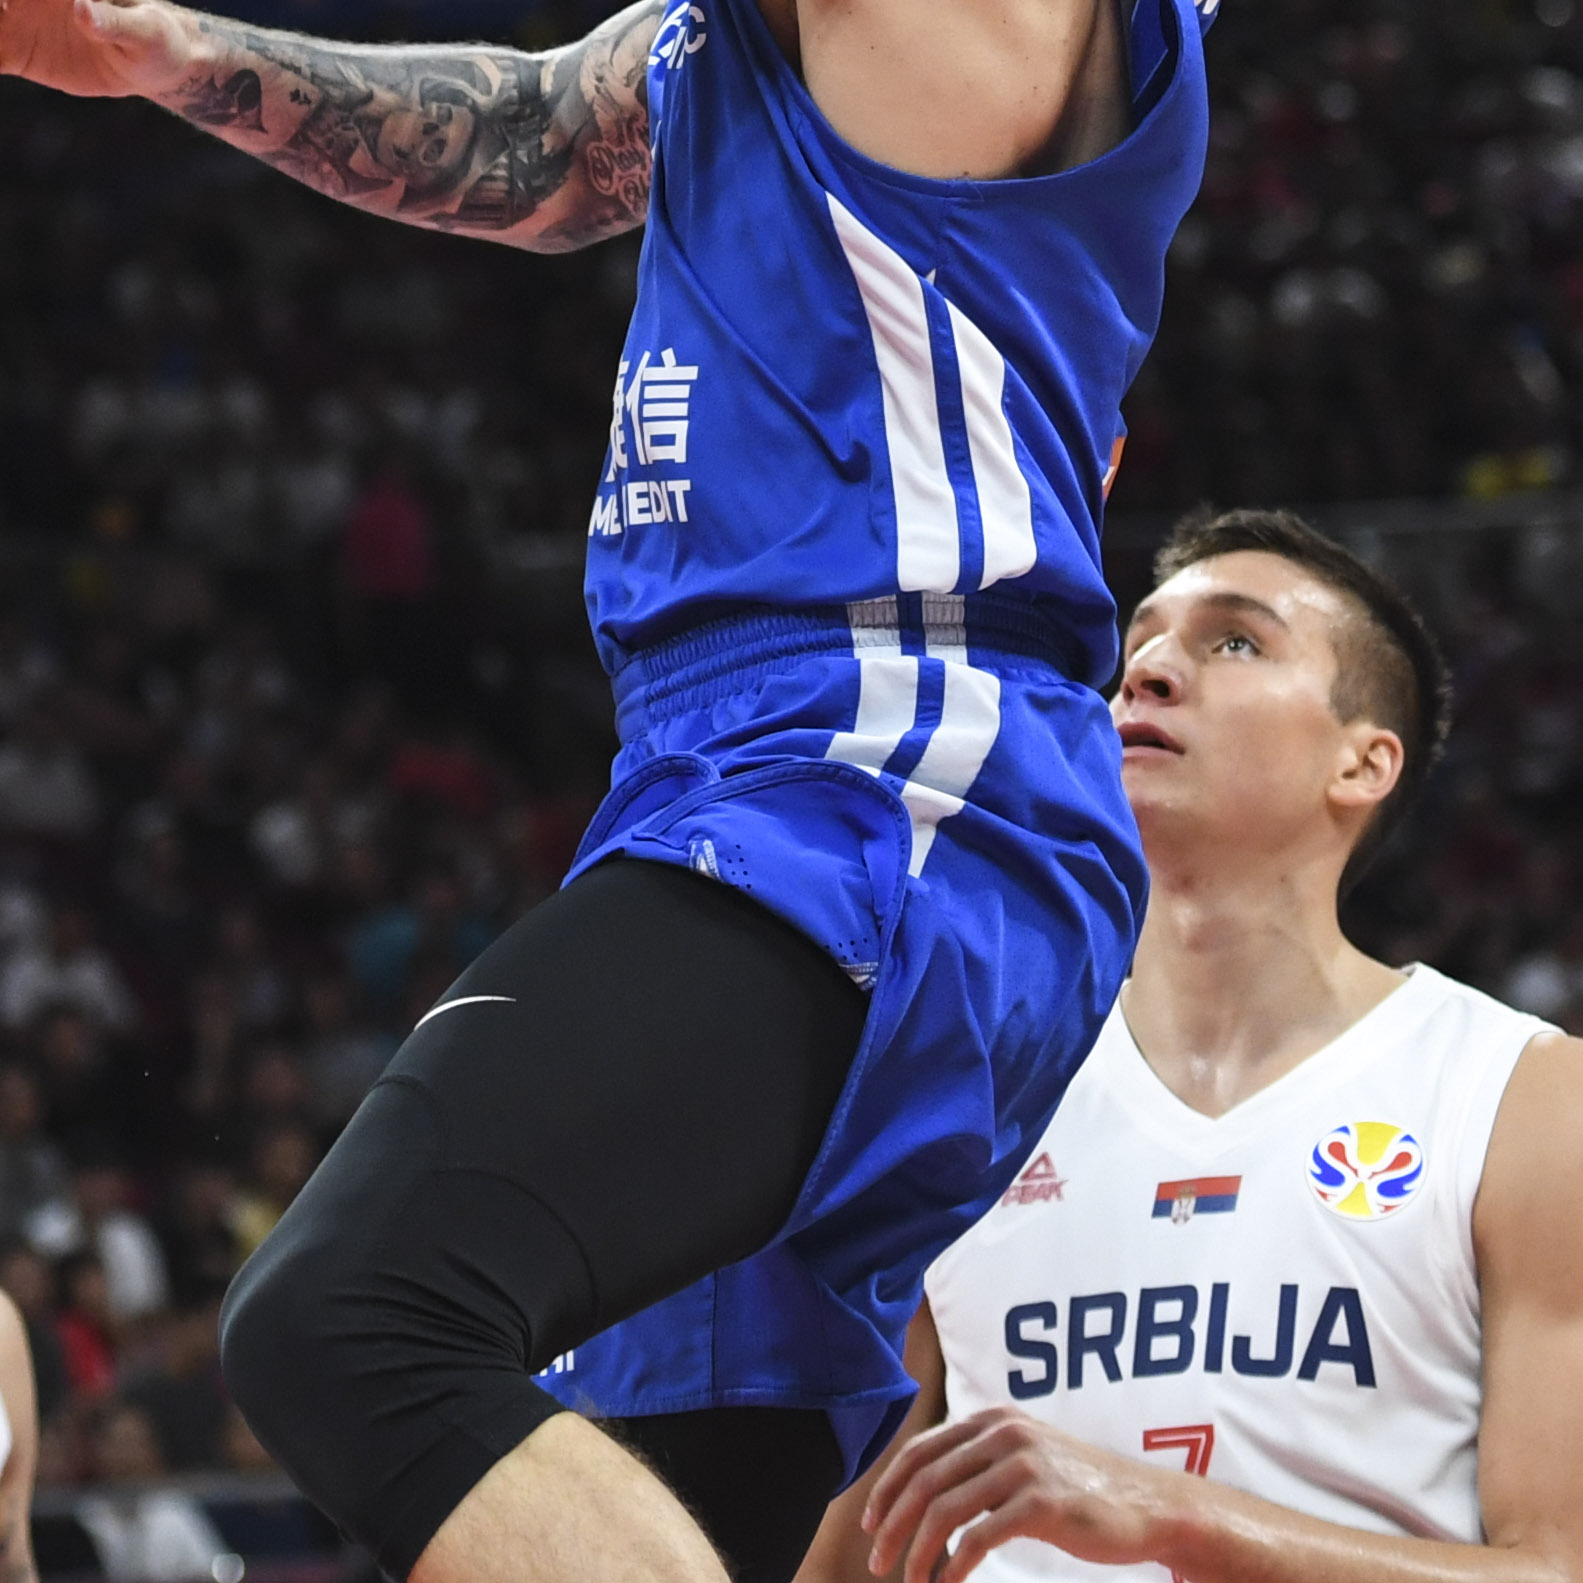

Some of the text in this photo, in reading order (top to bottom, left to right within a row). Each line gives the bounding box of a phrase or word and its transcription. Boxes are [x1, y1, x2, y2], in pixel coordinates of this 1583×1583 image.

[588, 479, 691, 536] ME EDIT
[1004, 1282, 1377, 1401] SRBIJA
